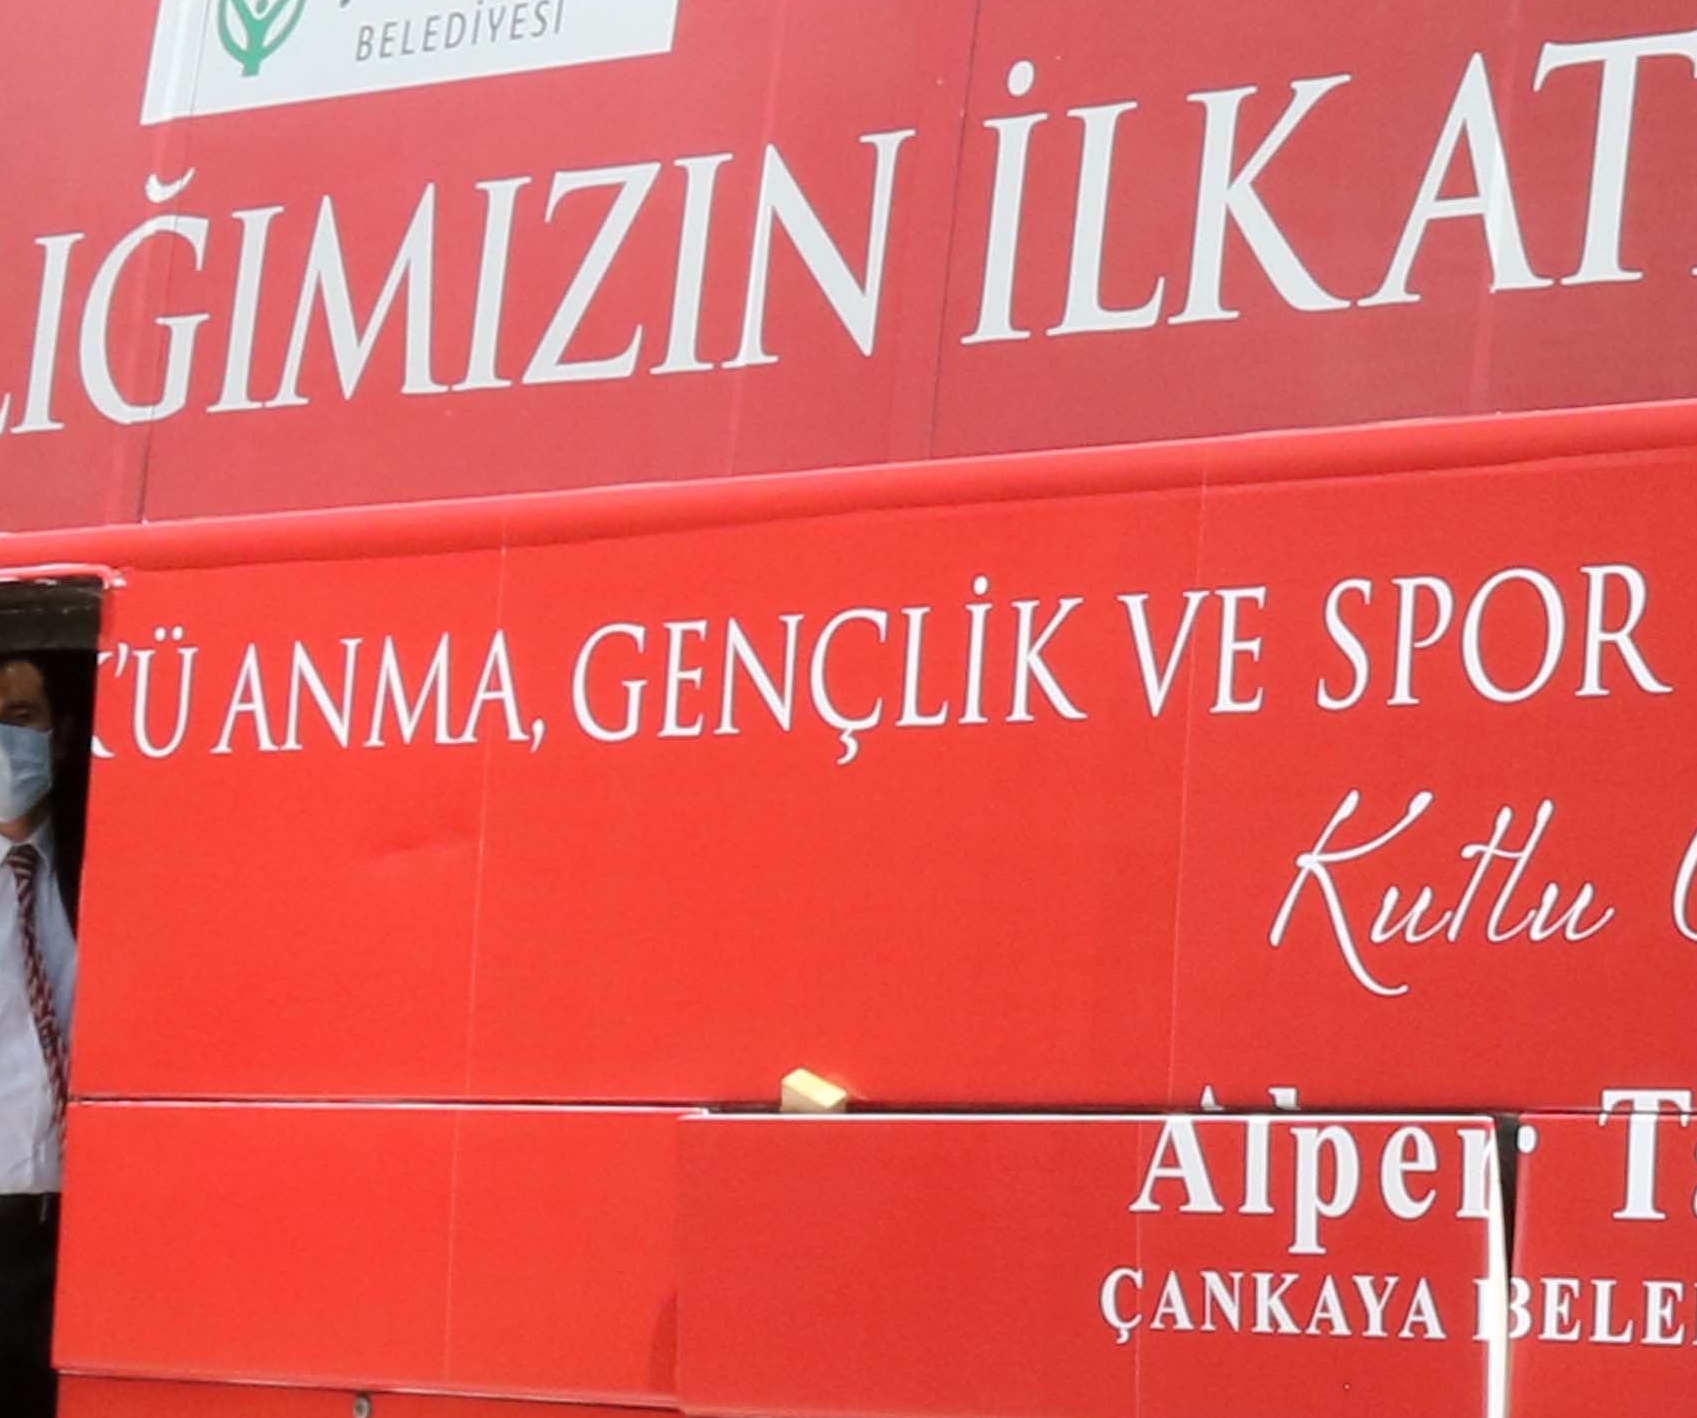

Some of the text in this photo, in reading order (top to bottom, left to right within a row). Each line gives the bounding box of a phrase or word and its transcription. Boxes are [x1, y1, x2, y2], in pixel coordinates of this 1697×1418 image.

[209, 629, 545, 754] ANMA,
[571, 575, 1088, 765] GENÇLİK
[1117, 585, 1267, 718] VE
[1316, 564, 1673, 711] SPOR
[1269, 790, 1615, 996] Kutlu
[1128, 1085, 1538, 1256] Alper
[1100, 1267, 1447, 1344] ÇANKAYA
